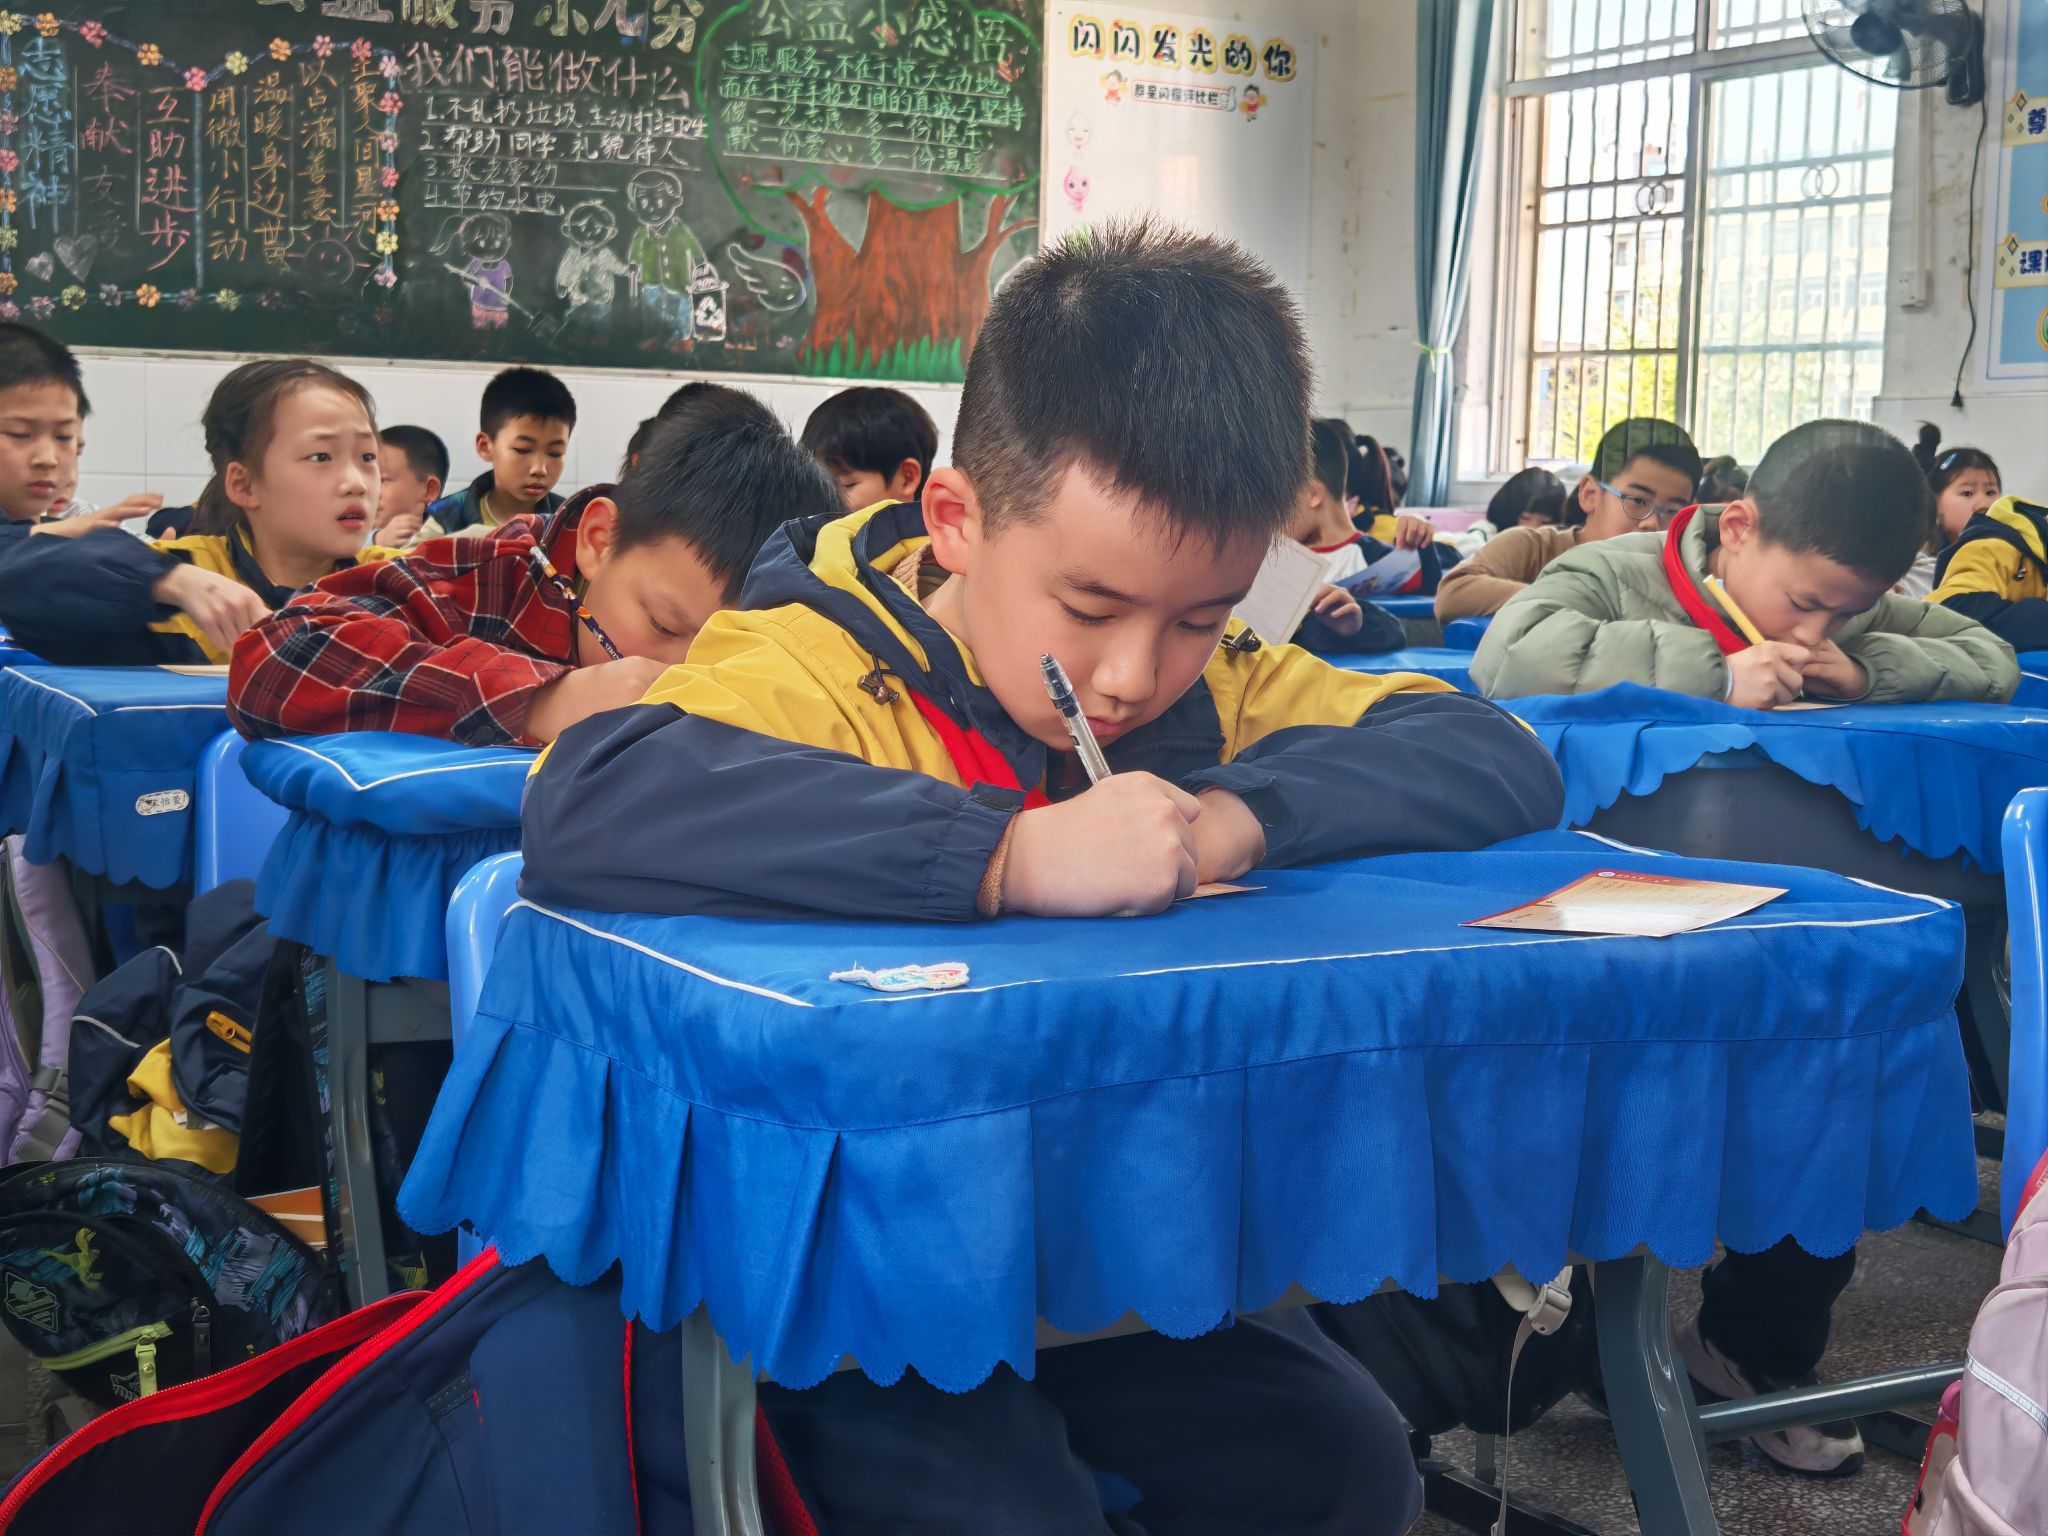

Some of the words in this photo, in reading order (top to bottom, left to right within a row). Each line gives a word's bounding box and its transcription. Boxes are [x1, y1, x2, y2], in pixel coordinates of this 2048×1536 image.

[402, 41, 690, 109] 我们能做什么
[1073, 19, 1293, 77] 闪闪发光的你
[16, 36, 76, 234] 志愿精神
[141, 86, 198, 272] 互助进步
[205, 85, 248, 262] 用微小行动
[2019, 248, 2048, 275] 课
